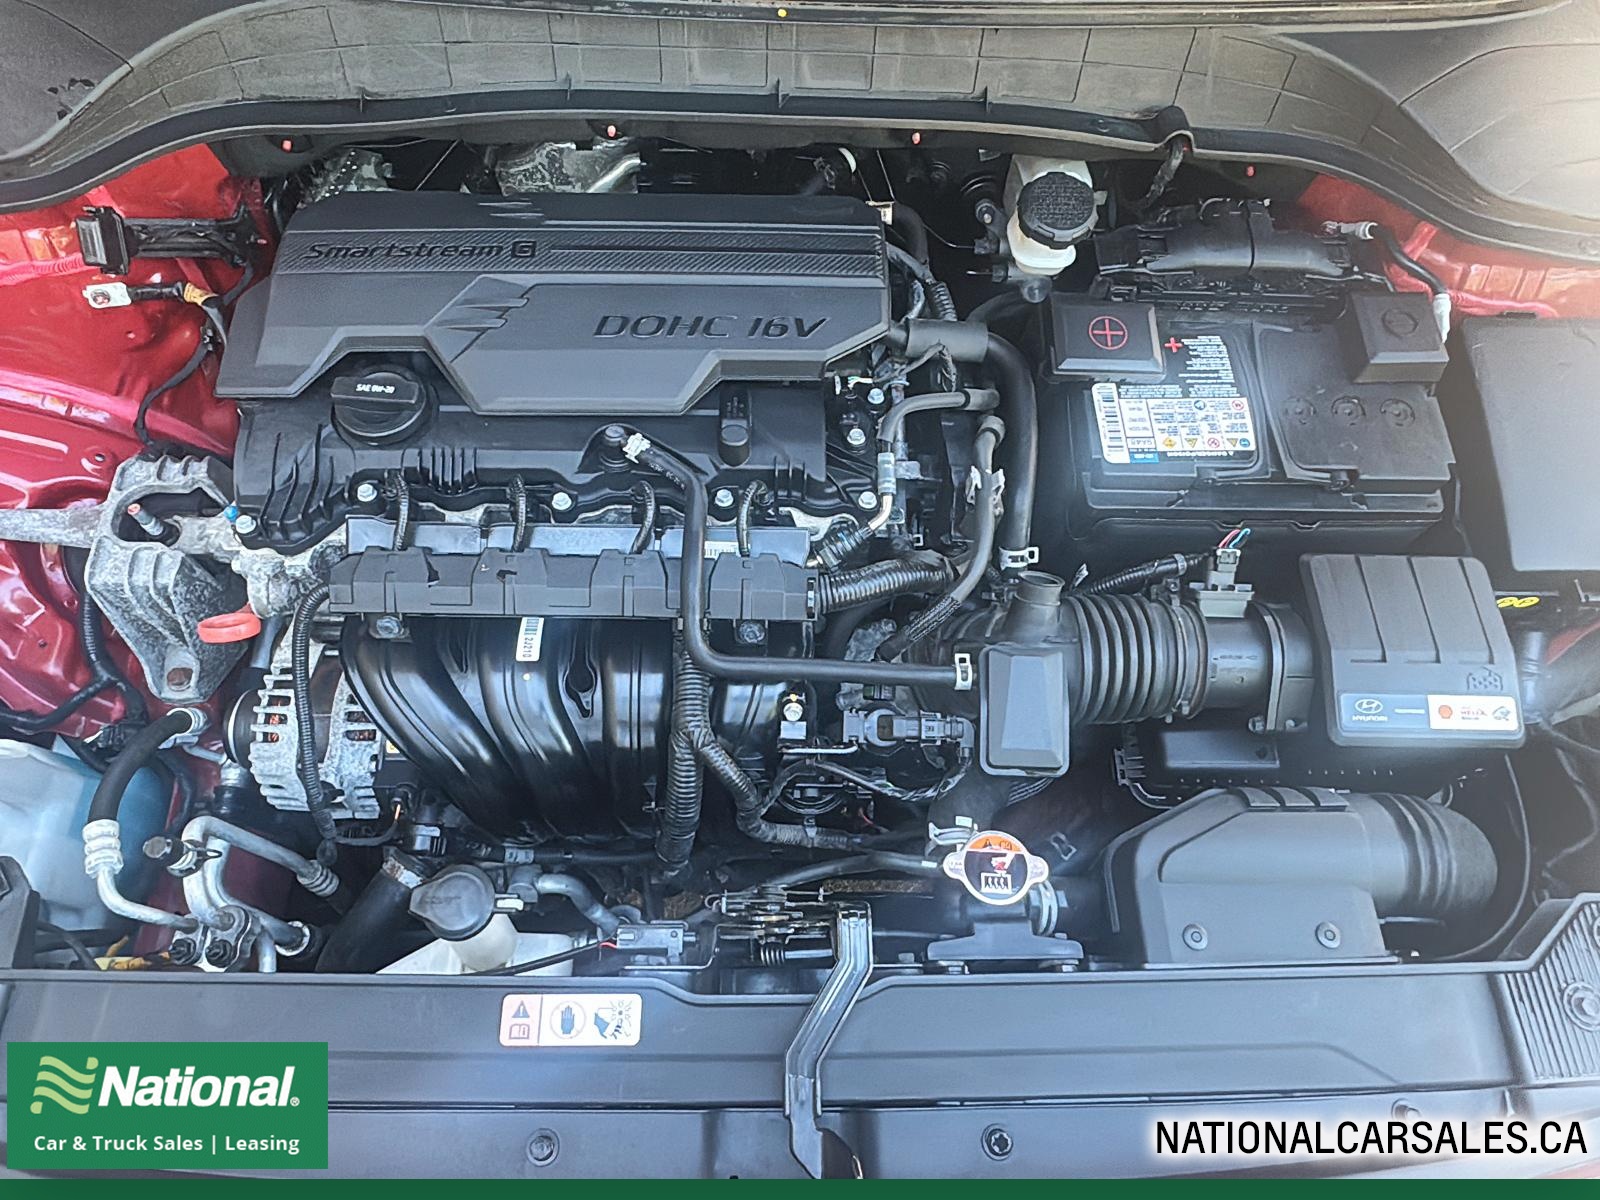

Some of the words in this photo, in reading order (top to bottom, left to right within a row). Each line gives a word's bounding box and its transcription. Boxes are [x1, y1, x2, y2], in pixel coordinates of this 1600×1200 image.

[302, 240, 504, 259] Smartstream
[593, 315, 738, 338] DOHC
[748, 315, 831, 338] 16V
